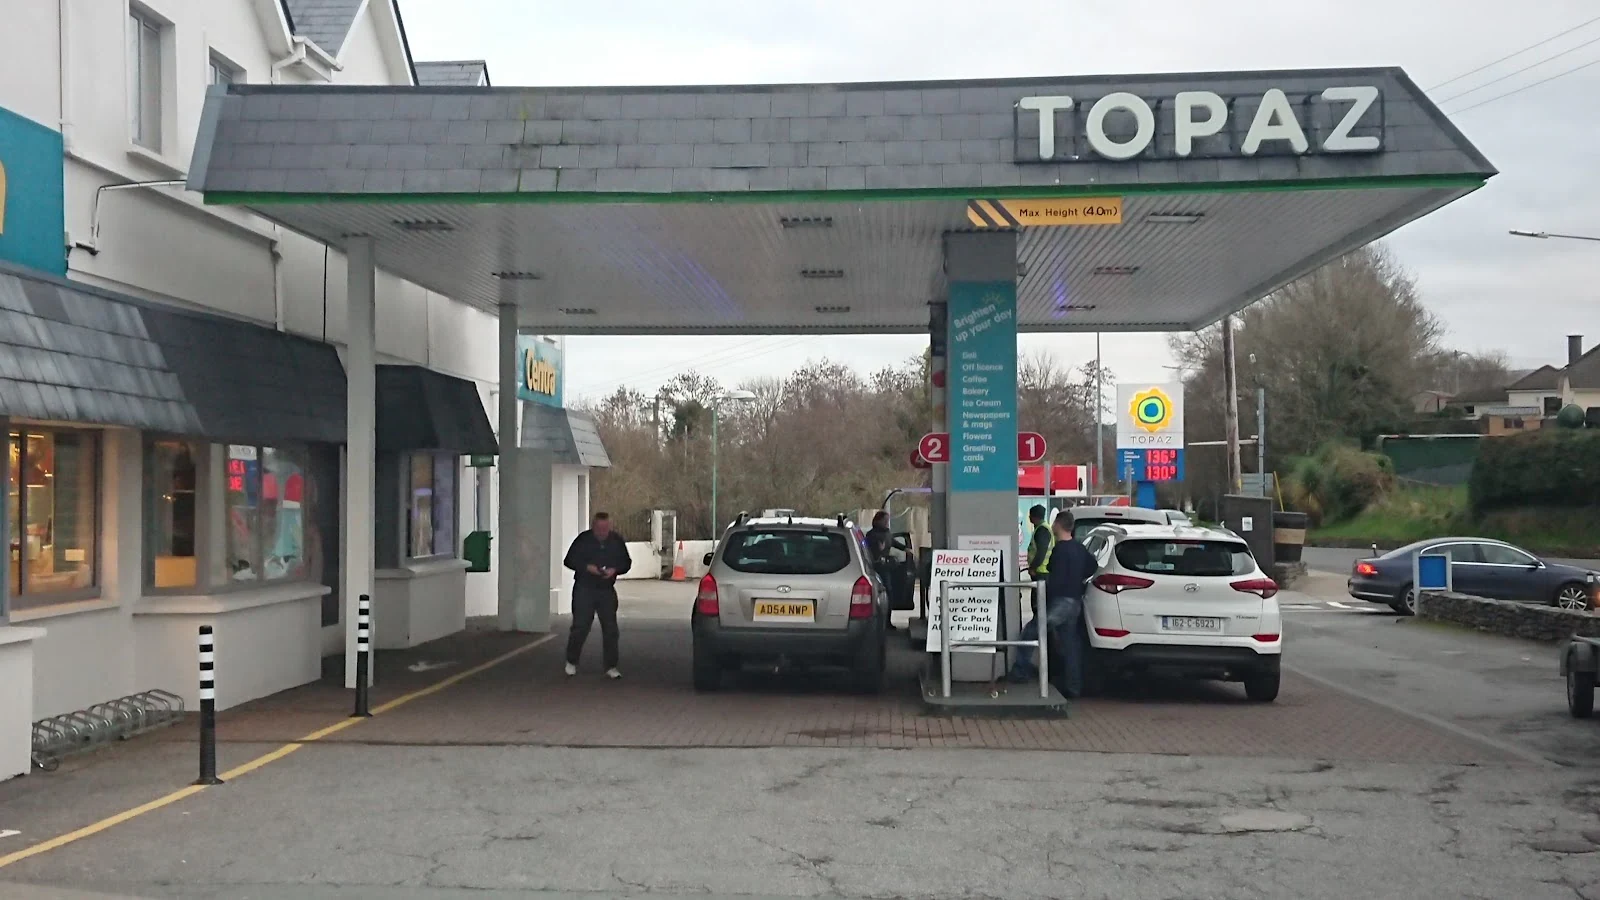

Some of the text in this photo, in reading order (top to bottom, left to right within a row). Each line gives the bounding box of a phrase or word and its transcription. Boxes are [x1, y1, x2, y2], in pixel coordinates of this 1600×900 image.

[1020, 86, 1380, 159] TOPAZ
[1019, 206, 1118, 217] Max Height (4.0m)
[954, 303, 996, 328] Brighten
[955, 309, 1012, 342] up your day
[525, 348, 556, 397] Centra
[962, 388, 989, 396] Bakery
[962, 412, 1010, 420] Newspapers
[971, 421, 993, 429] mags
[962, 432, 992, 440] Flowers
[1130, 436, 1172, 444] TOPAZ
[927, 438, 942, 458] 2
[962, 444, 996, 453] Greeting
[1025, 437, 1036, 457] 1
[936, 554, 999, 566] Please Keep
[934, 567, 997, 577] Petrol Lanes
[936, 596, 965, 604] Pase
[760, 604, 808, 615] AD54 NWP
[957, 624, 993, 634] Fueling.
